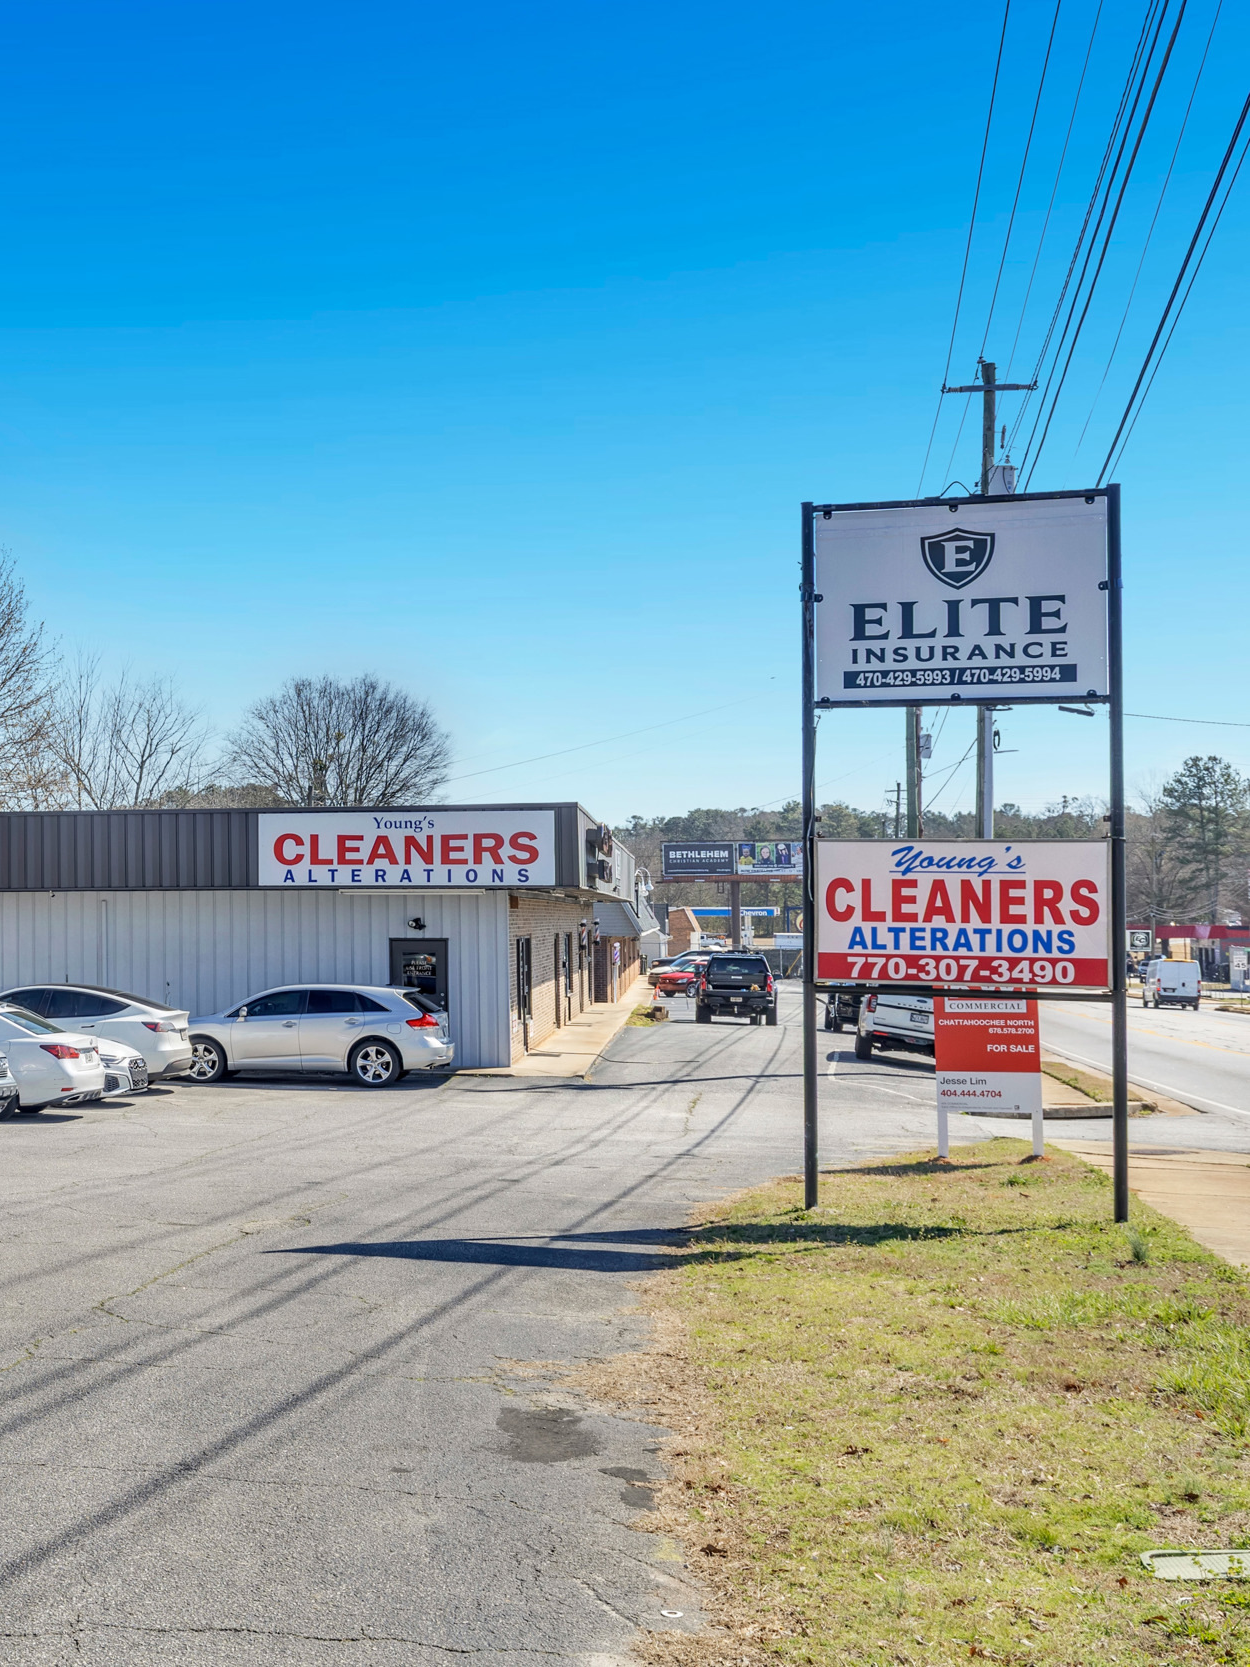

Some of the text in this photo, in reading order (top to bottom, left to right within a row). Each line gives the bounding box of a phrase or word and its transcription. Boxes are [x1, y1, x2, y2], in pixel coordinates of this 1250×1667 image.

[940, 540, 976, 573] E
[848, 594, 1069, 642] ELITE
[851, 641, 1069, 665] INSURANCE
[856, 667, 1061, 686] 470-429-5993 / 470-429-5994
[372, 816, 435, 833] Young's
[273, 831, 540, 866] CLEANERS
[669, 850, 729, 859] BETHLEHEM
[890, 845, 1026, 877] Young's
[283, 868, 530, 883] ALTERATIONS
[825, 877, 1100, 926] CLEANERS
[740, 909, 768, 917] Chevron
[847, 926, 1076, 955] ALTERATIONS
[847, 956, 1076, 984] 770-307-3490
[949, 1002, 1023, 1011] COMMERCIAL
[987, 1044, 1036, 1053] FOR SALE
[940, 1077, 987, 1085] Jesse Lim
[940, 1089, 1002, 1098] 404.444.4704
